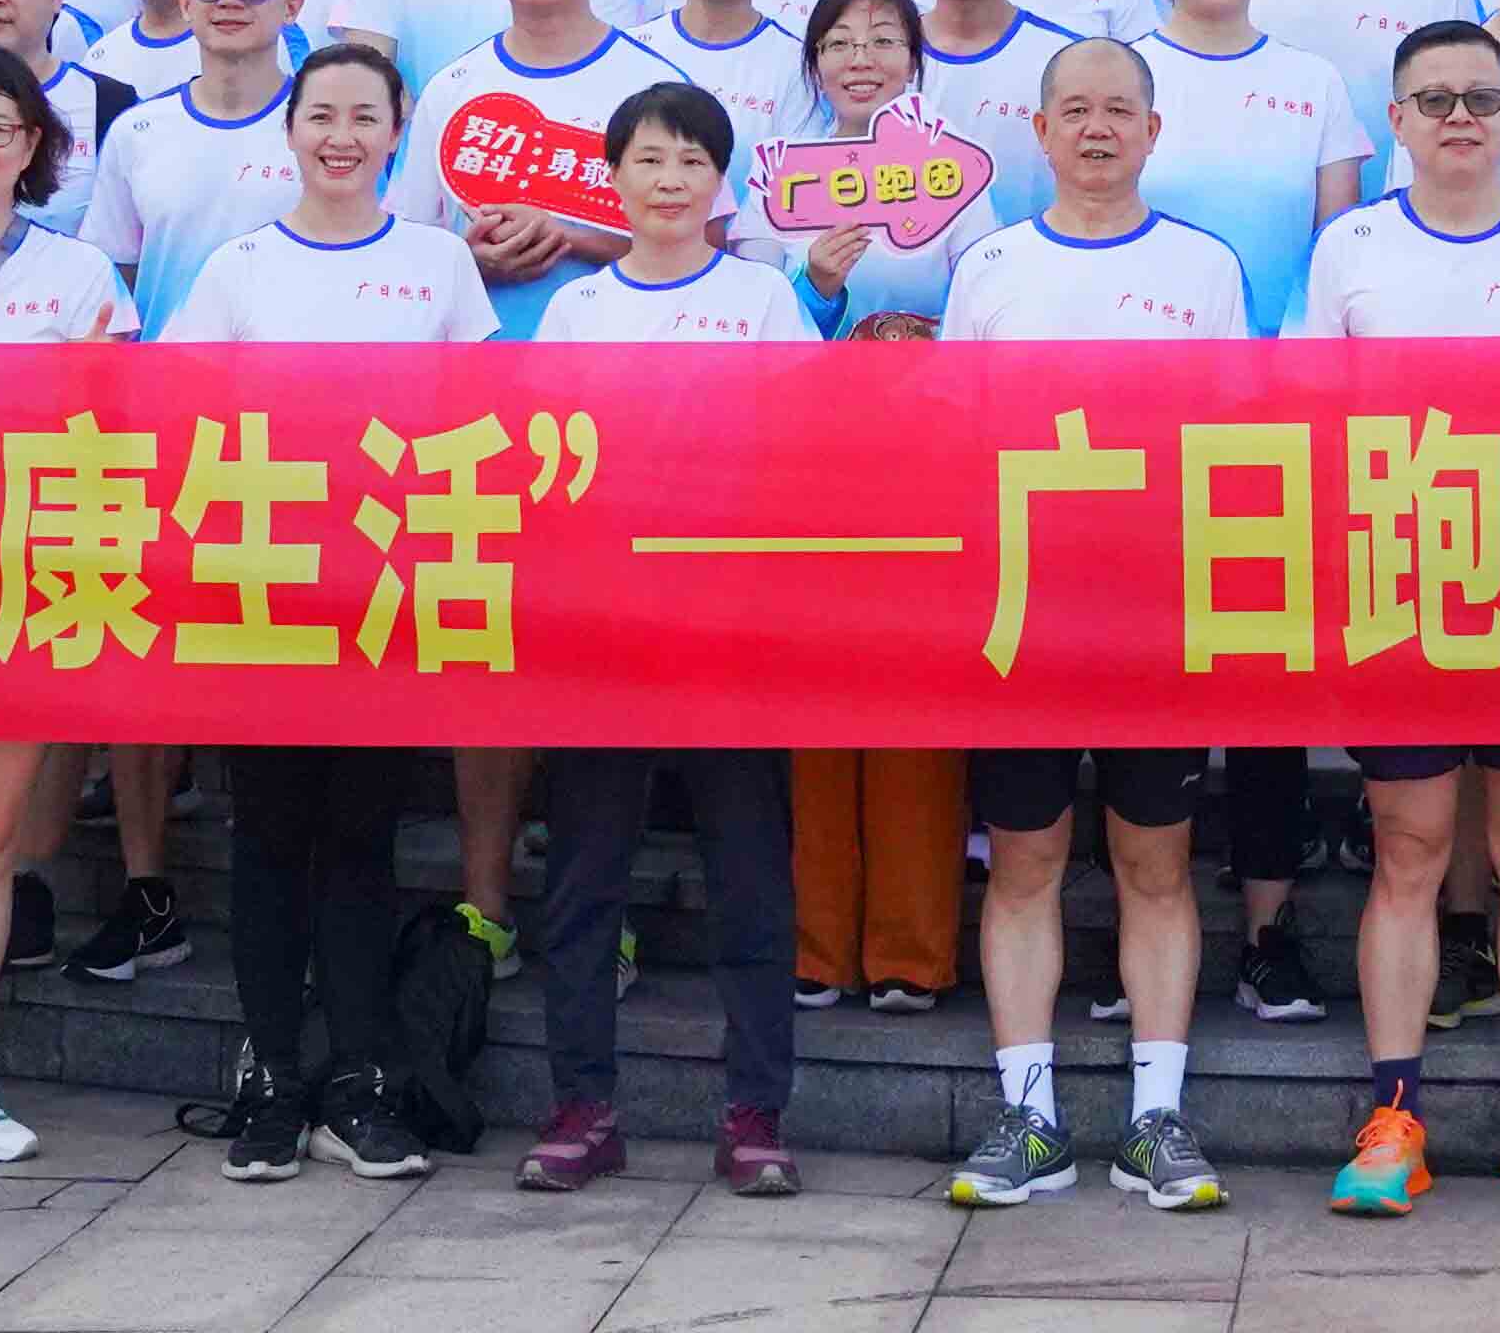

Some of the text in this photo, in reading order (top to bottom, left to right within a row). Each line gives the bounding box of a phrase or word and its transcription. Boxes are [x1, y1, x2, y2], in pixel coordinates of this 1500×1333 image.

[459, 115, 526, 156] 努力
[452, 145, 516, 182] 奋斗
[542, 147, 613, 190] 勇敢
[779, 157, 963, 210] 广日跑团
